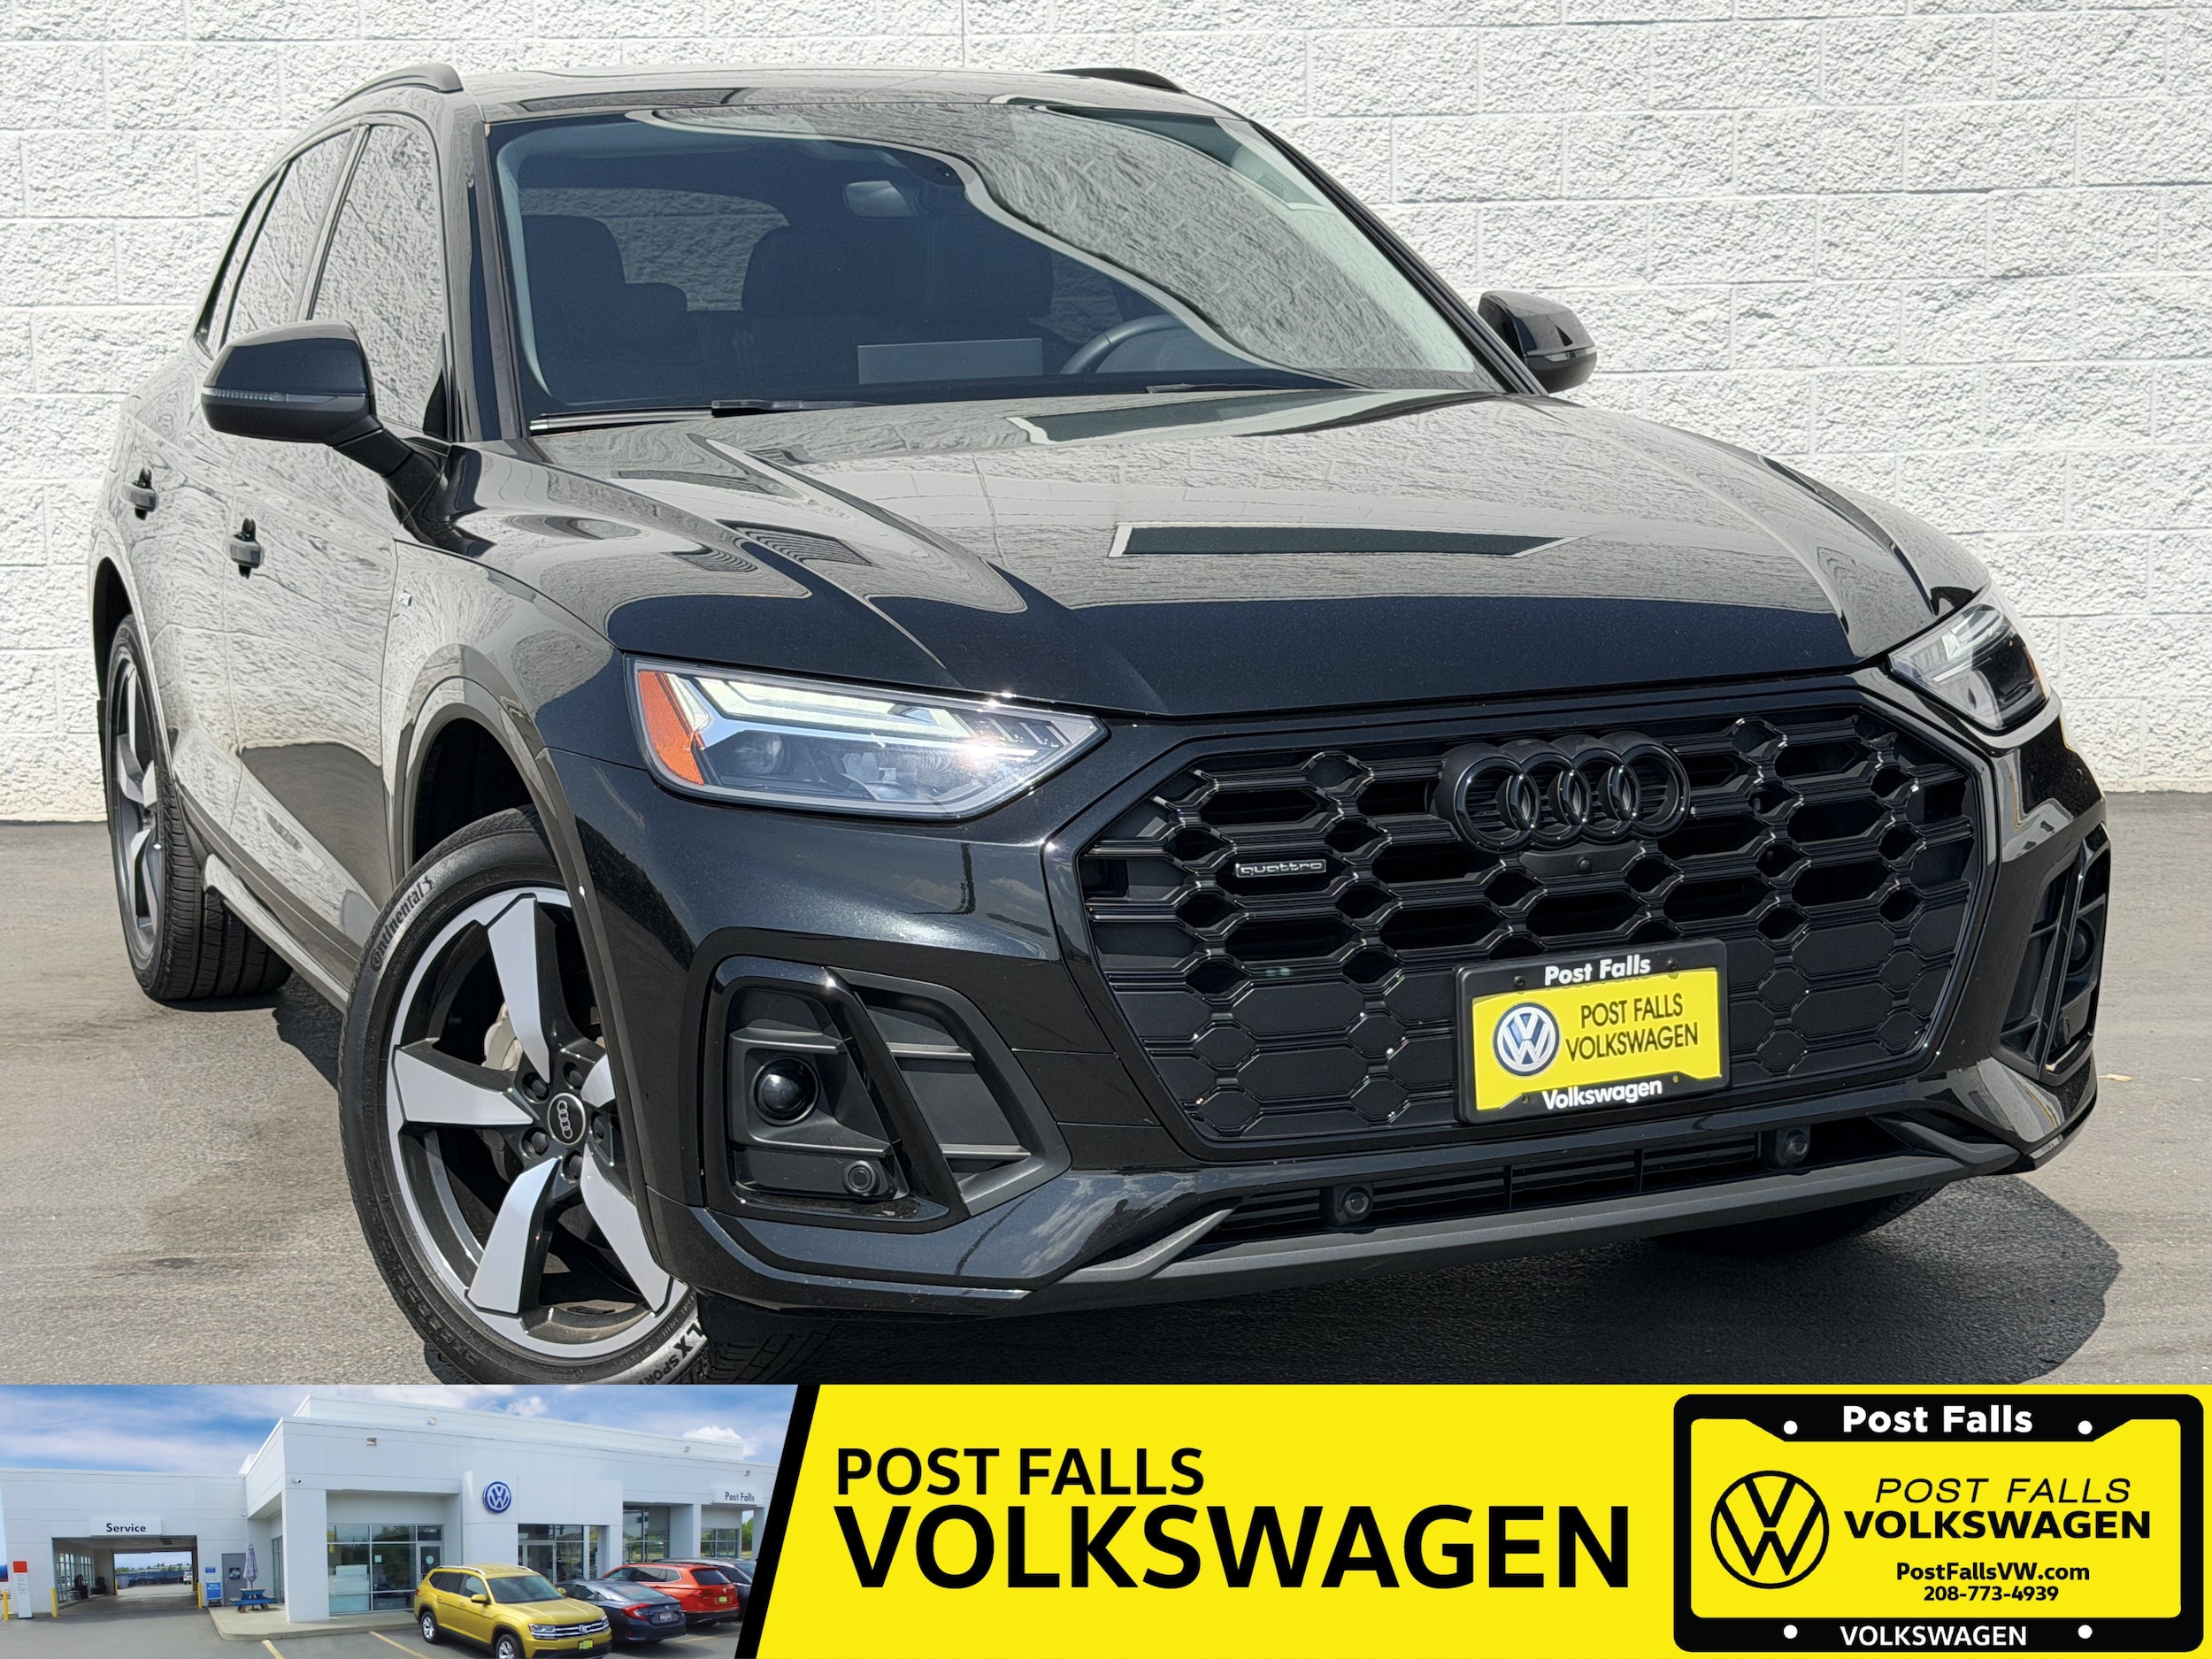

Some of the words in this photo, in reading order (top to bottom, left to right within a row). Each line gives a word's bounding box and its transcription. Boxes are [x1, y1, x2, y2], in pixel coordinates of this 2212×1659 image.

[1240, 863, 1323, 875] quattro
[1545, 963, 1593, 986] Post
[1599, 955, 1651, 979] Falls
[1581, 1000, 1627, 1028] POST
[1633, 993, 1683, 1022] FALLS
[1494, 1003, 1559, 1076] VW
[1565, 1022, 1698, 1061] VOLKSWAGEN
[1542, 1080, 1663, 1110] Volkswagen
